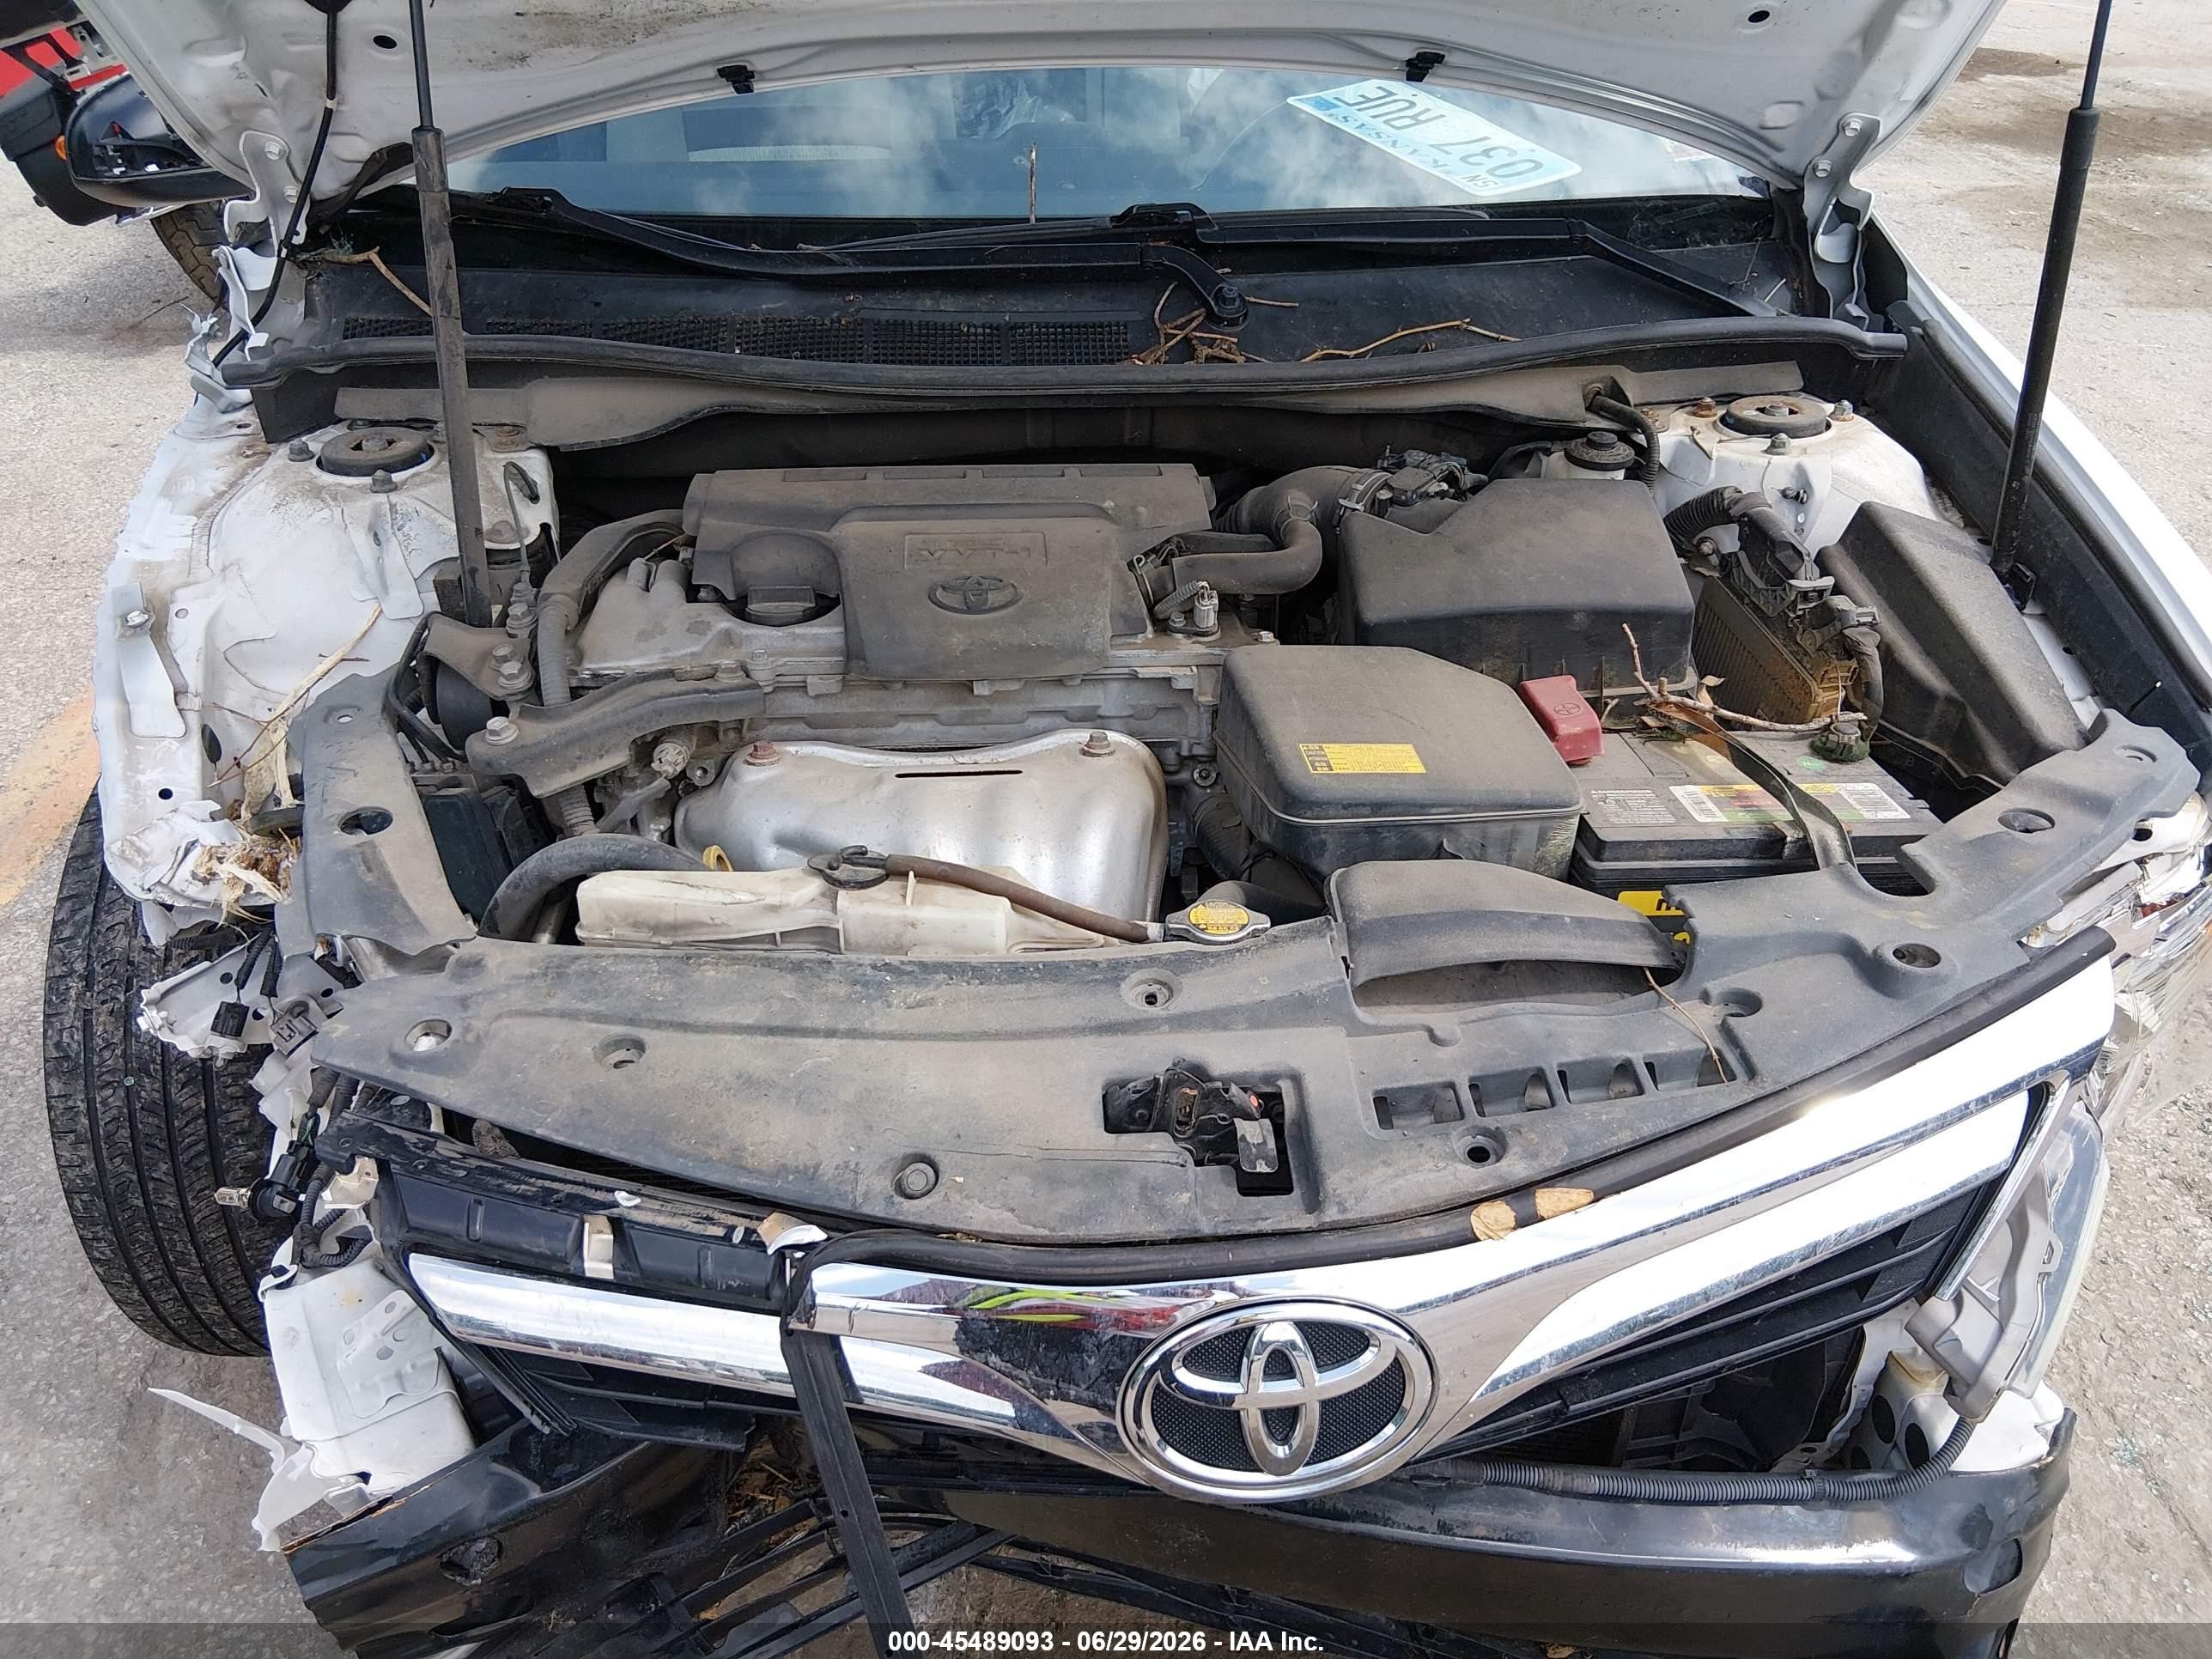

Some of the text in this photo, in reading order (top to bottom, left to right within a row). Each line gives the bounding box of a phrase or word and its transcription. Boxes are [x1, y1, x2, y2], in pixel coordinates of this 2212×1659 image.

[1333, 86, 1544, 178] 037 RUE
[1335, 115, 1449, 168] KANSAS
[1462, 173, 1498, 188] SN
